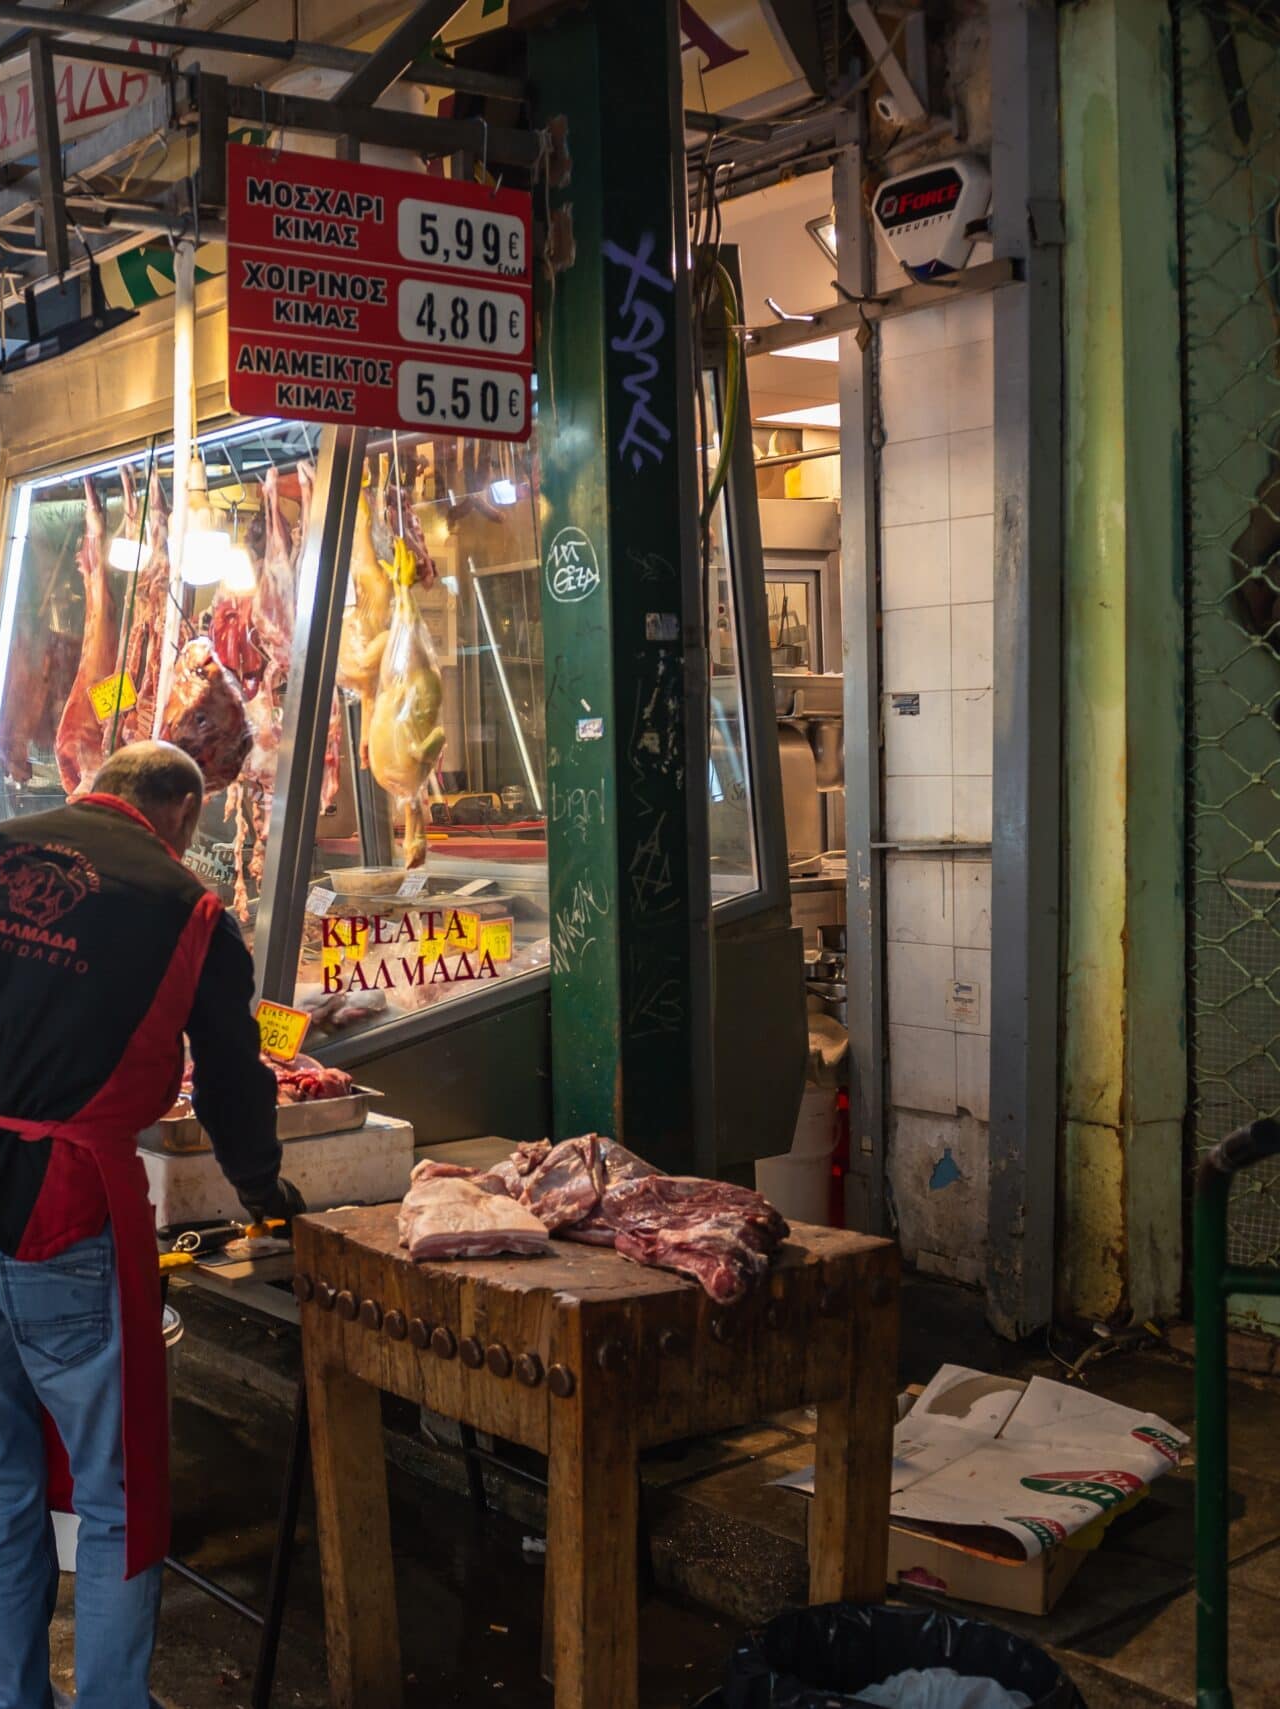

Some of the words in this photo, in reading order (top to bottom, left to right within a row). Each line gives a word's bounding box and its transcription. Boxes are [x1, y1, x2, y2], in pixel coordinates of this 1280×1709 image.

[246, 177, 384, 224] ΜΟΣΧΑΡΙ
[273, 215, 359, 250] ΚΙΜΑΣ
[888, 213, 951, 237] SECURITY
[241, 259, 387, 305] ΧΟΙΡΙΝΟΣ
[273, 298, 359, 332] ΚΙΜΑΣ
[236, 344, 393, 388] ΑΝΑΜΕΙΚΤΟΣ
[276, 383, 355, 415] ΚΙΜΑΣ
[320, 908, 468, 948] ΚΡΕΑΤΑ
[321, 949, 501, 994] ΒΑΛΜΑΔΑ
